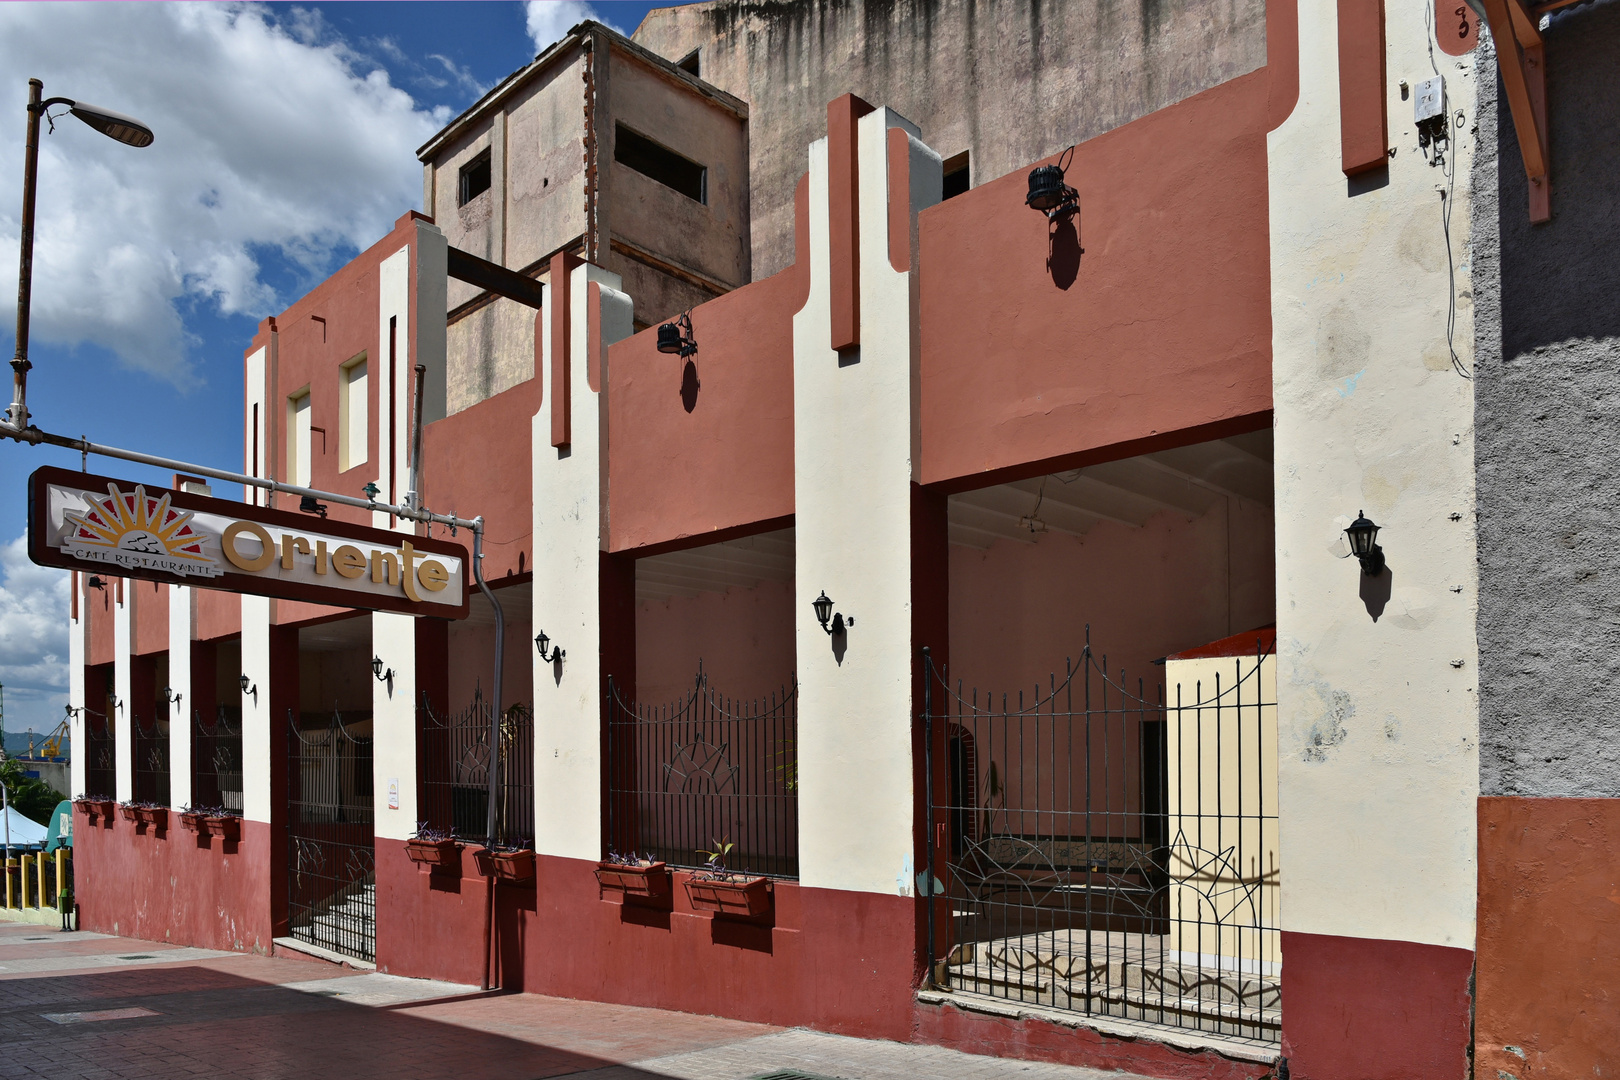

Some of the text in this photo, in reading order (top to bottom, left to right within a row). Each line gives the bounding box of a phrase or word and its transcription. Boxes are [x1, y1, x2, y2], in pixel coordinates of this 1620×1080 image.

[75, 549, 212, 574] CAFÉ RESTAURANTE
[221, 520, 449, 602] Oriente
